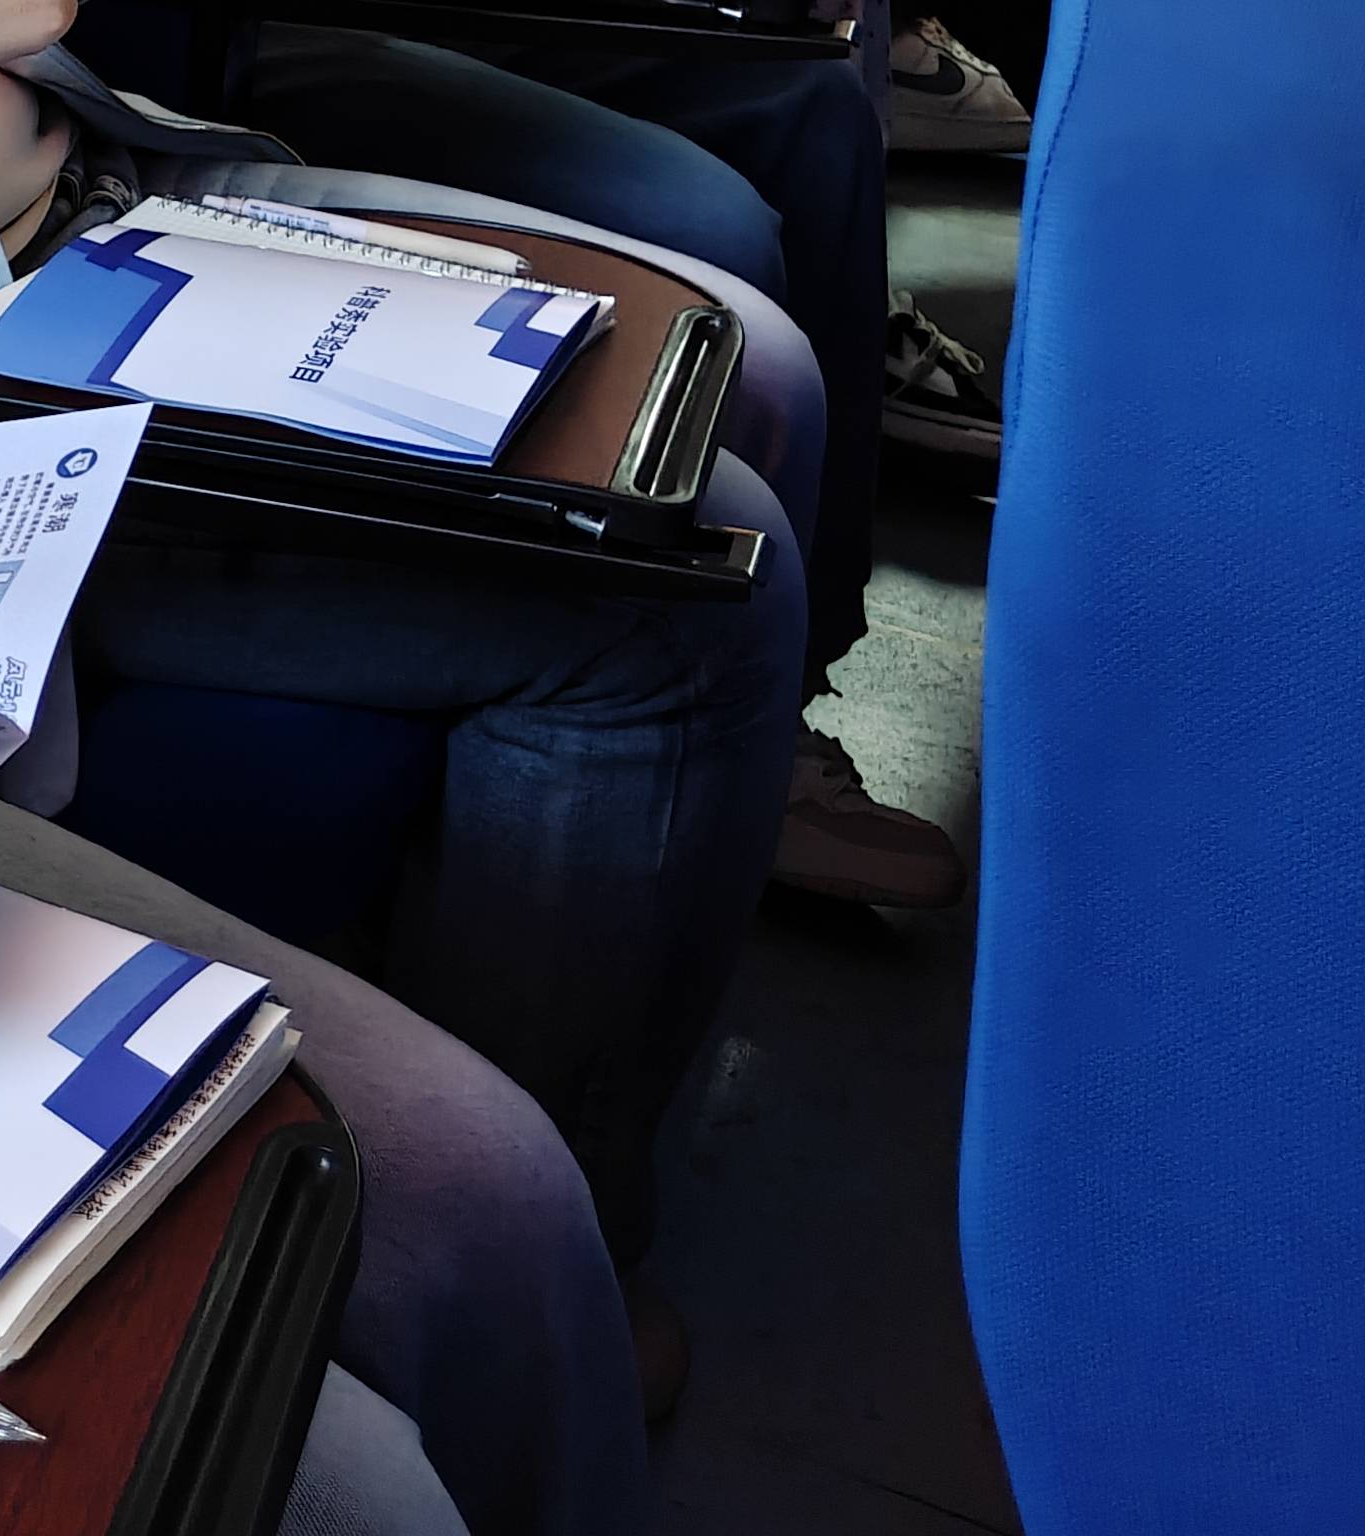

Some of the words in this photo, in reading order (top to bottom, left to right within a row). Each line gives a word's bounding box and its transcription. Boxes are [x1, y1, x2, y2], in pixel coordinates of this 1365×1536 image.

[287, 284, 390, 385] 科普秀实验项目
[41, 492, 80, 534] 寒潮
